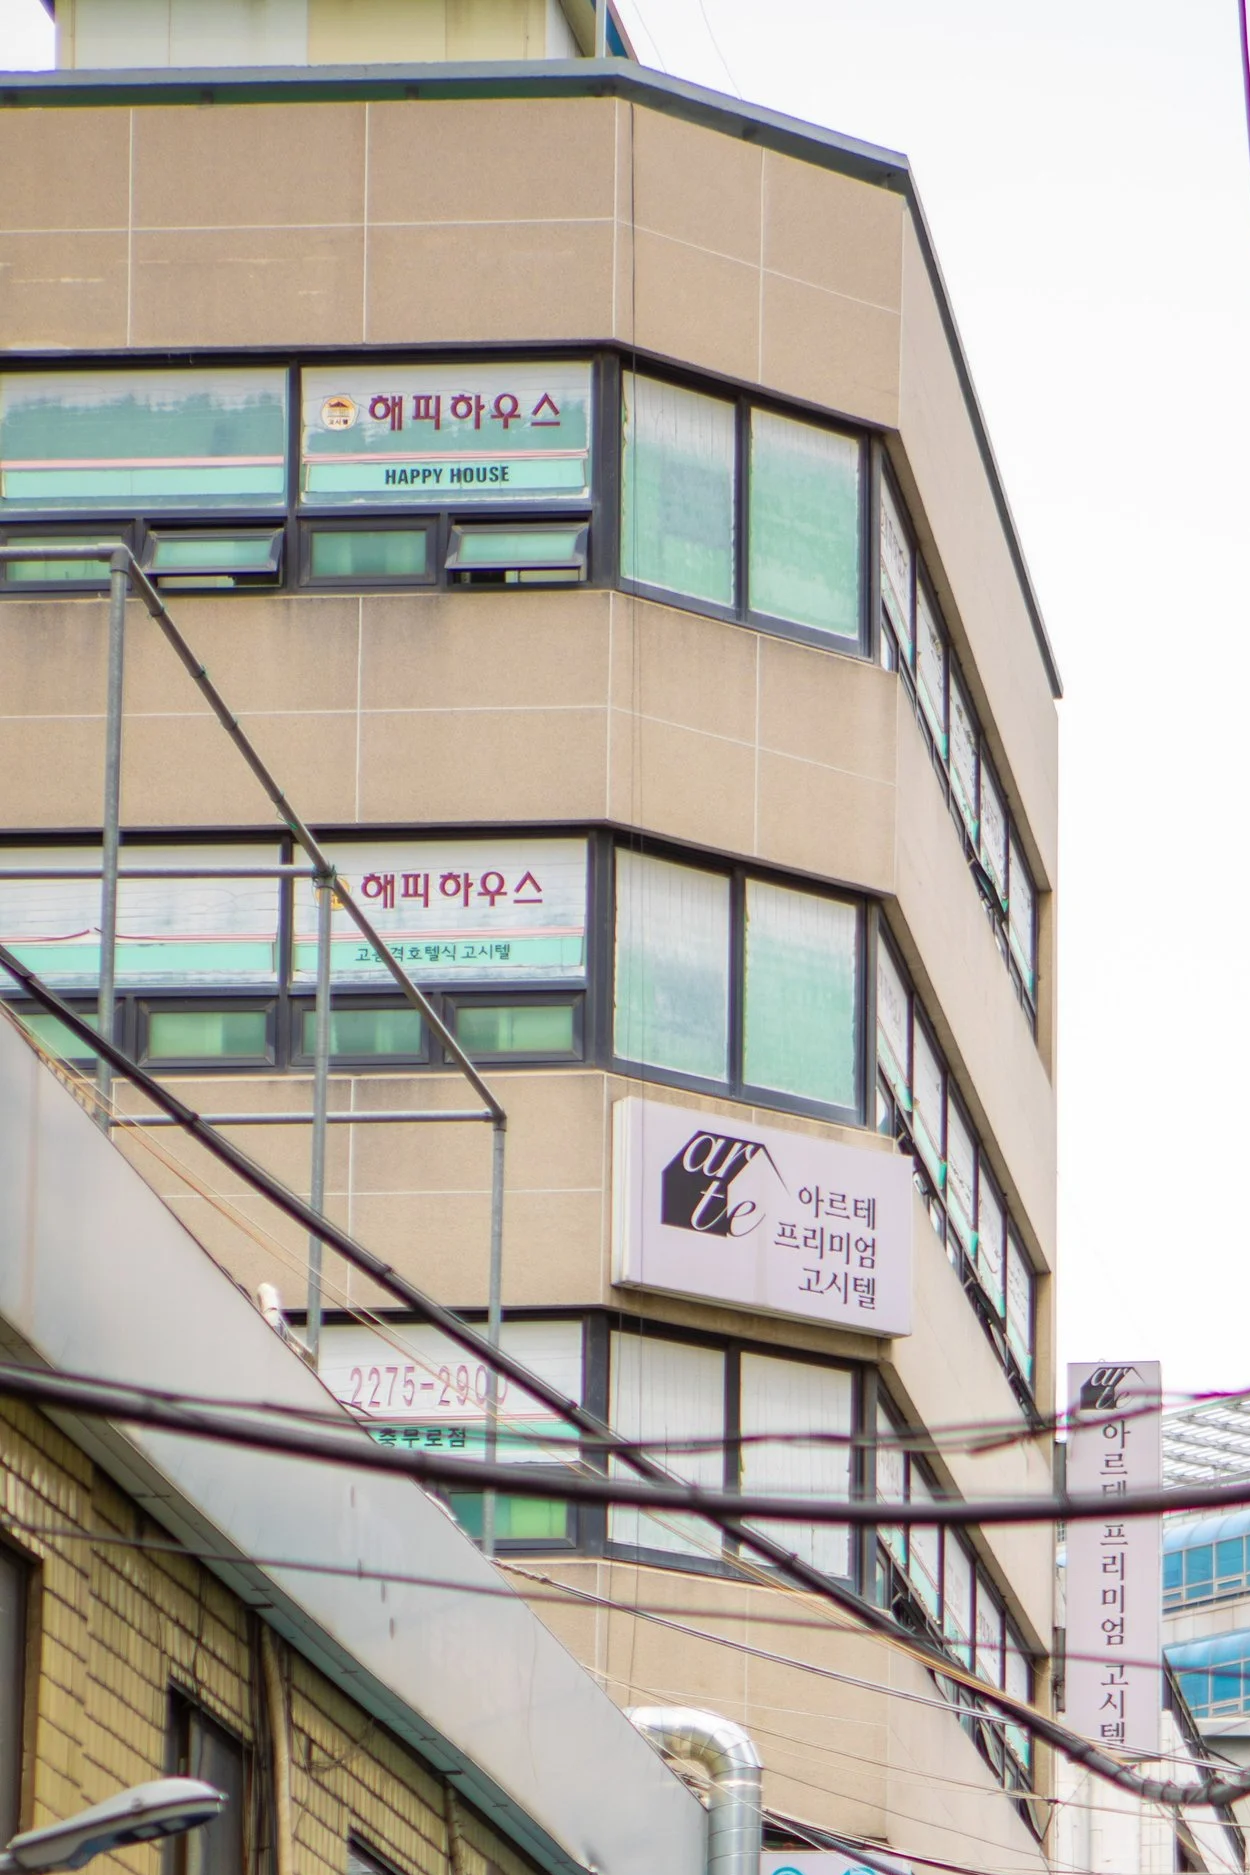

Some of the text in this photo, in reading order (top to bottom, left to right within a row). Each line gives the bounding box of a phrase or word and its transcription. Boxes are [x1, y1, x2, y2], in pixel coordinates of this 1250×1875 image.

[368, 392, 561, 431] 해피하우스
[384, 465, 510, 485] HAPPY HOUSE
[361, 871, 543, 908] 해피하우스
[460, 943, 511, 961] 고시텔
[798, 1184, 876, 1231] 아르테
[773, 1220, 876, 1270] 프리미엄
[797, 1267, 876, 1311] 고시텔
[1100, 1523, 1130, 1646] 프리미엄
[1099, 1664, 1130, 1751] 고시텔
